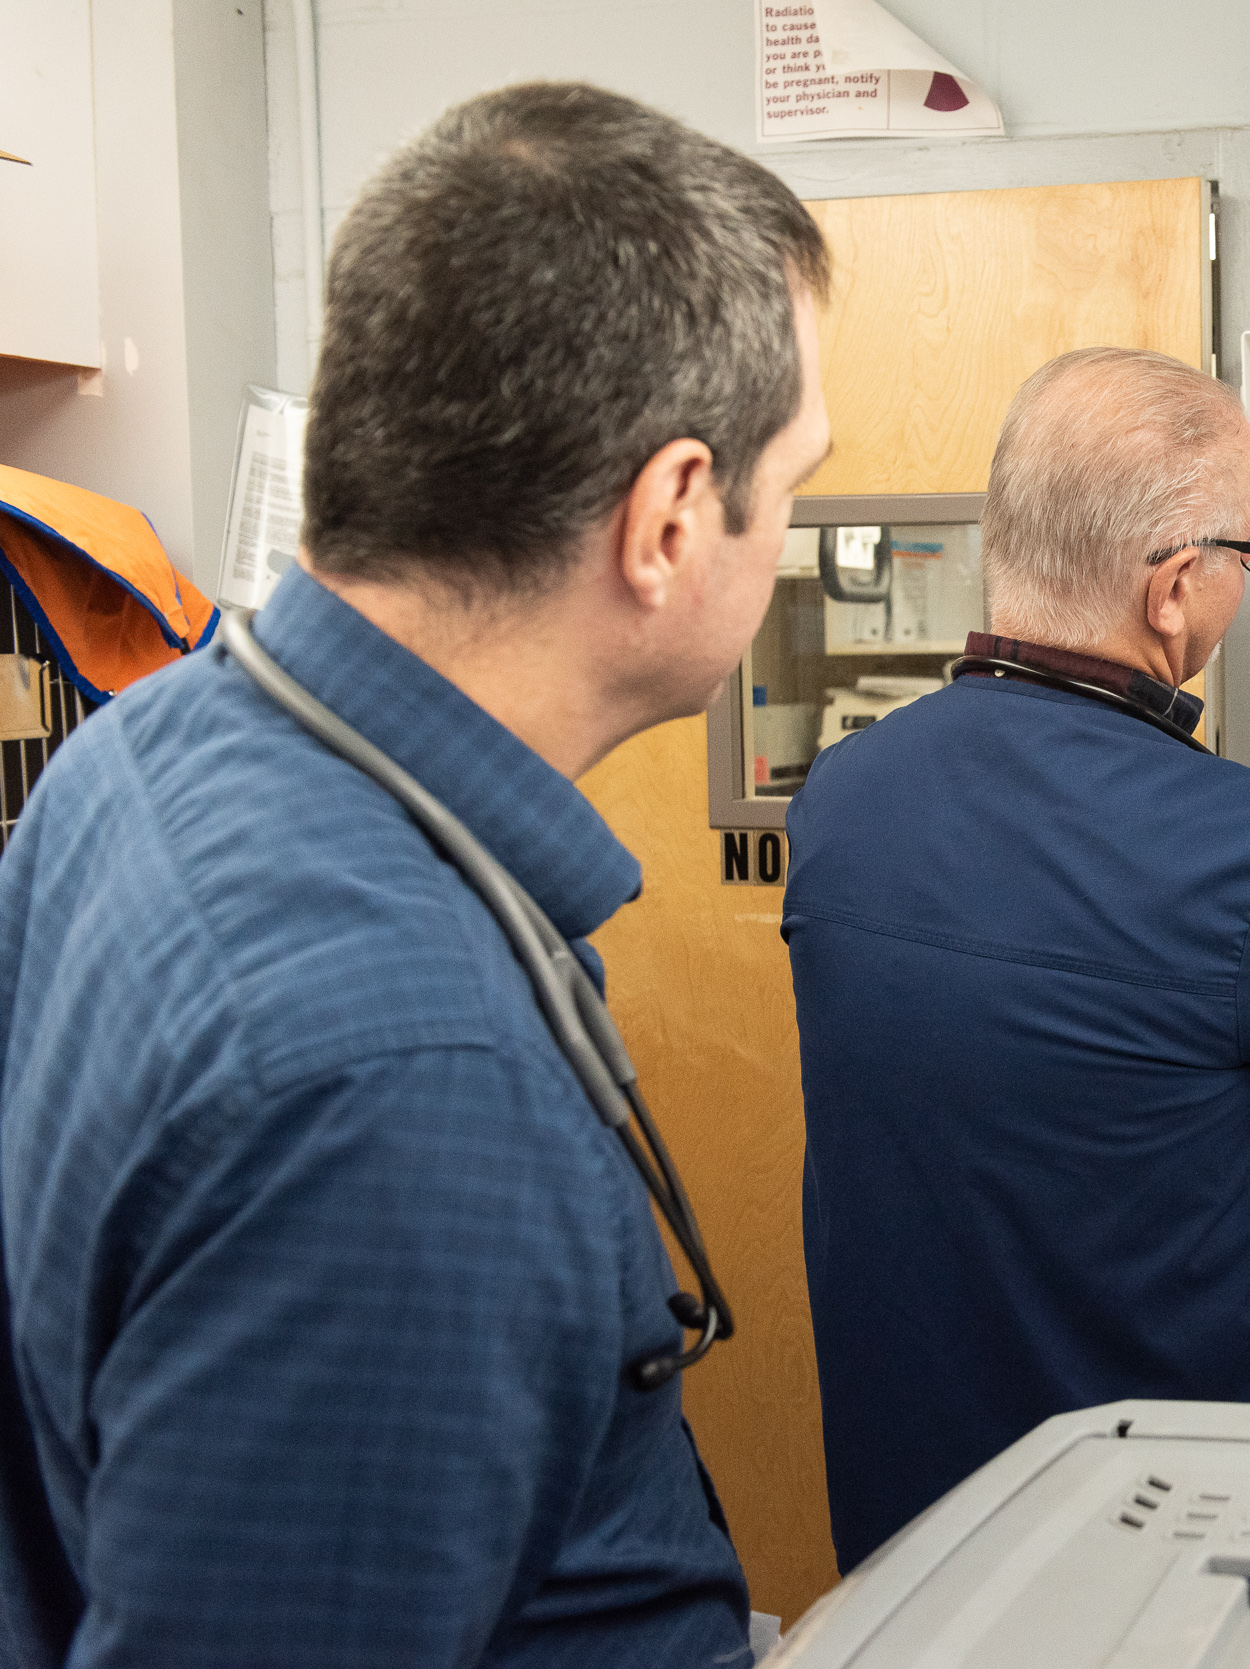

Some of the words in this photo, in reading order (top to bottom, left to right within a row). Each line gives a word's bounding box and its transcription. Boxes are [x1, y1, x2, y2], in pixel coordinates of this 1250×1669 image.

[766, 22, 778, 32] to
[782, 21, 816, 32] cause
[766, 35, 802, 47] health
[766, 52, 786, 62] you
[790, 50, 809, 59] are
[766, 66, 776, 76] or
[782, 62, 810, 74] think
[765, 80, 779, 90] be
[784, 76, 839, 90] pregnant,
[844, 73, 881, 86] notify
[766, 94, 790, 105] your
[796, 89, 850, 103] physician
[855, 88, 878, 98] and
[766, 106, 830, 119] supervisor.
[723, 832, 782, 883] NO
